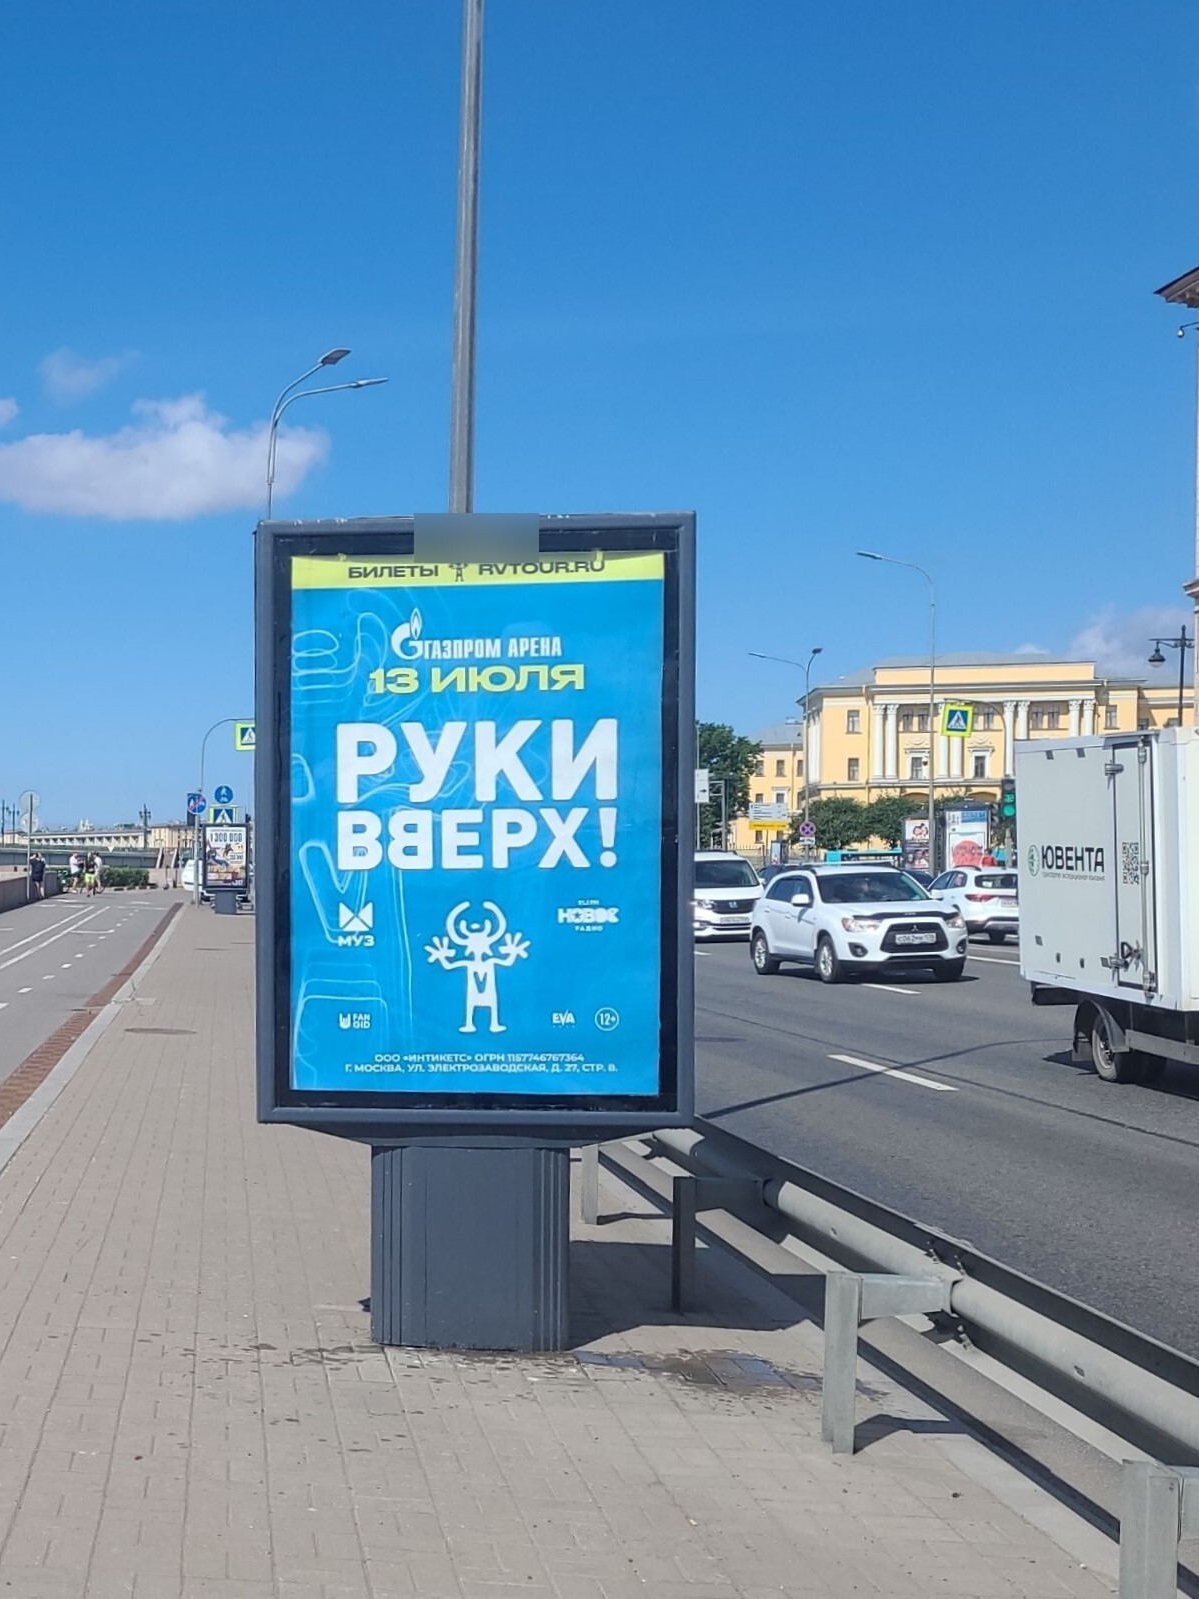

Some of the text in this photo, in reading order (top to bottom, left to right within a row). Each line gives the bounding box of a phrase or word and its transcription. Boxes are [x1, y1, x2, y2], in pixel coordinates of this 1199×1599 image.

[348, 565, 439, 579] БИЛЕТЫ
[478, 561, 605, 576] RVTOUR.RU
[423, 636, 563, 660] ГАЗПРОМ АРЕНА
[369, 664, 585, 694] 13 ИЮЛЯ
[337, 718, 619, 804] РУКИ
[1041, 845, 1105, 873] ЮВЕНТА
[557, 908, 620, 924] НОВОЕ
[338, 935, 375, 947] МУЗ
[353, 1013, 371, 1022] FAN
[599, 1012, 617, 1026] 12+
[353, 1021, 371, 1029] GID
[374, 1053, 401, 1063] ООО
[403, 1053, 473, 1063] «ИНТИКЕТС»
[474, 1053, 505, 1063] ОГРН
[345, 1063, 353, 1073] Г.
[354, 1063, 405, 1074] МОСКВА,
[407, 1063, 426, 1073] УЛ.
[428, 1063, 549, 1074] ЭЛЕКТРОЗАВОДСКАЯ,
[550, 1063, 563, 1074] Д.
[564, 1063, 580, 1074] 27,
[581, 1063, 607, 1073] СТР.
